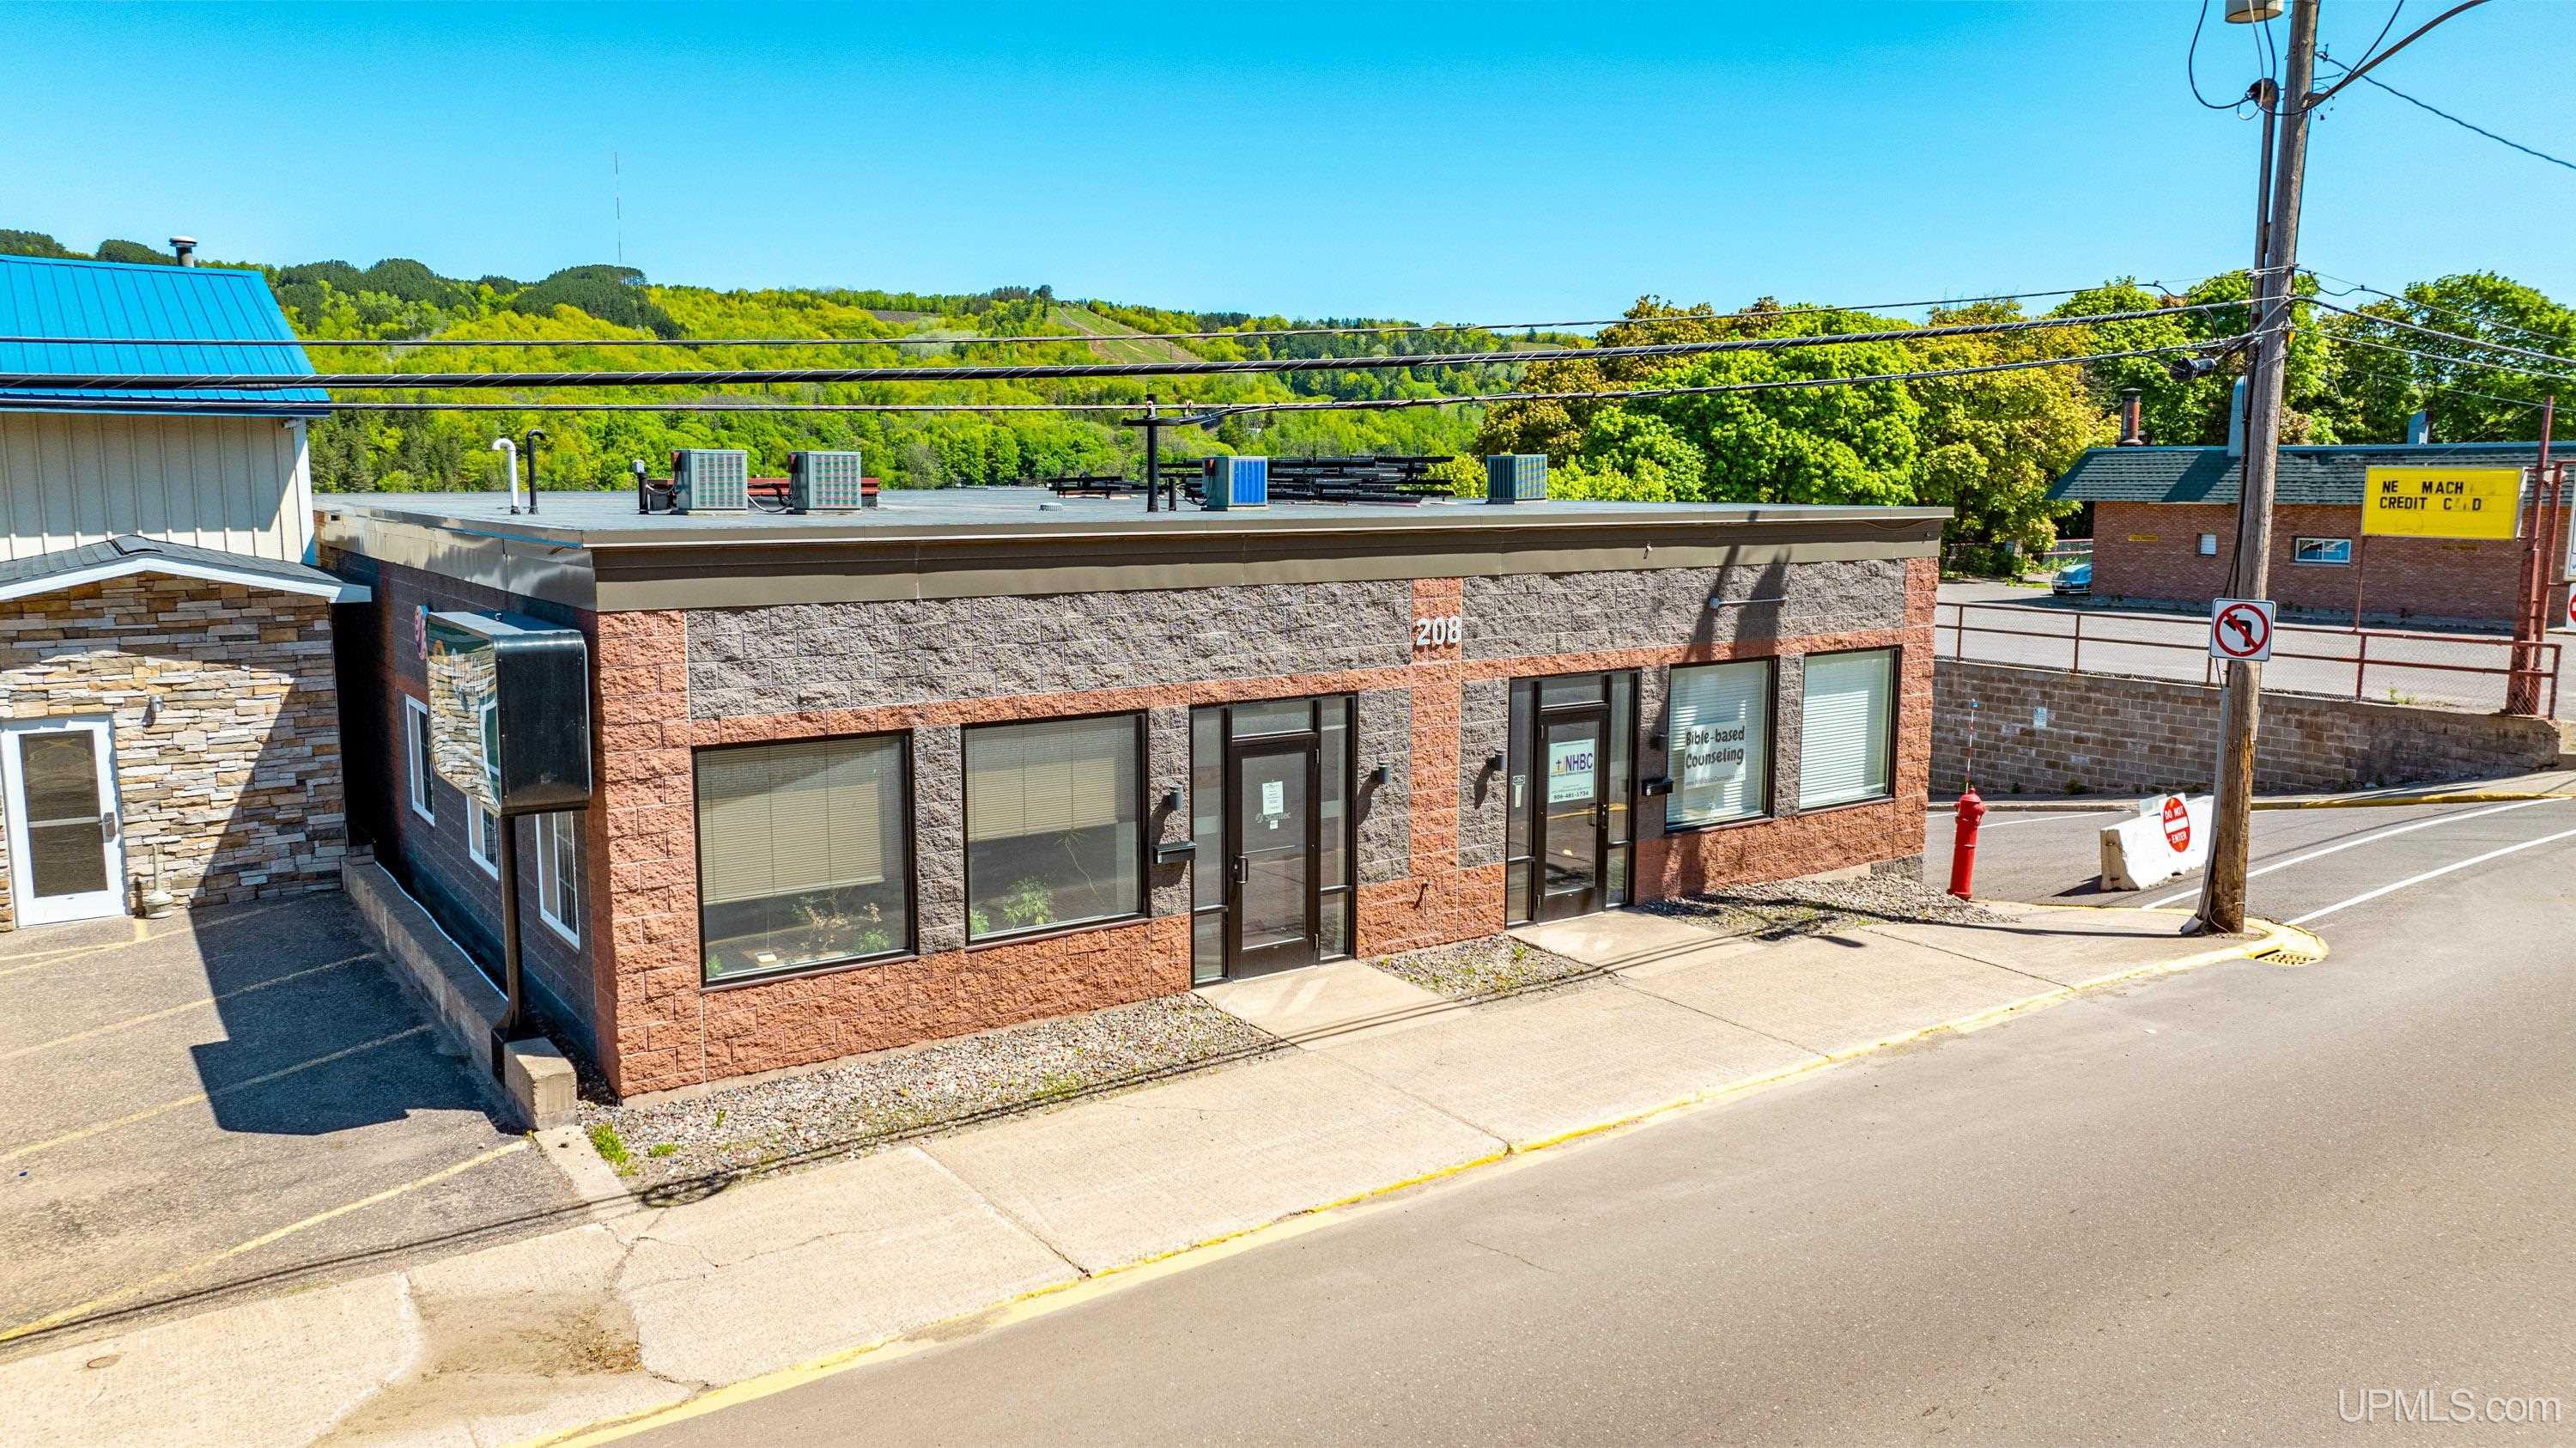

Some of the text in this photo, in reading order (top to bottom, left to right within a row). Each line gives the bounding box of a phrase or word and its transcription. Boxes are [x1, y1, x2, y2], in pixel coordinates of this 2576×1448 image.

[2382, 480, 2464, 495] NE MACH
[2379, 496, 2427, 510] CREDIT
[1415, 615, 1462, 646] 208
[1686, 726, 1745, 746] Bible-based
[1566, 752, 1593, 772] NHBC
[1686, 747, 1744, 769] Counseling
[2165, 806, 2184, 819] DO NOT
[2171, 831, 2186, 843] ENTER
